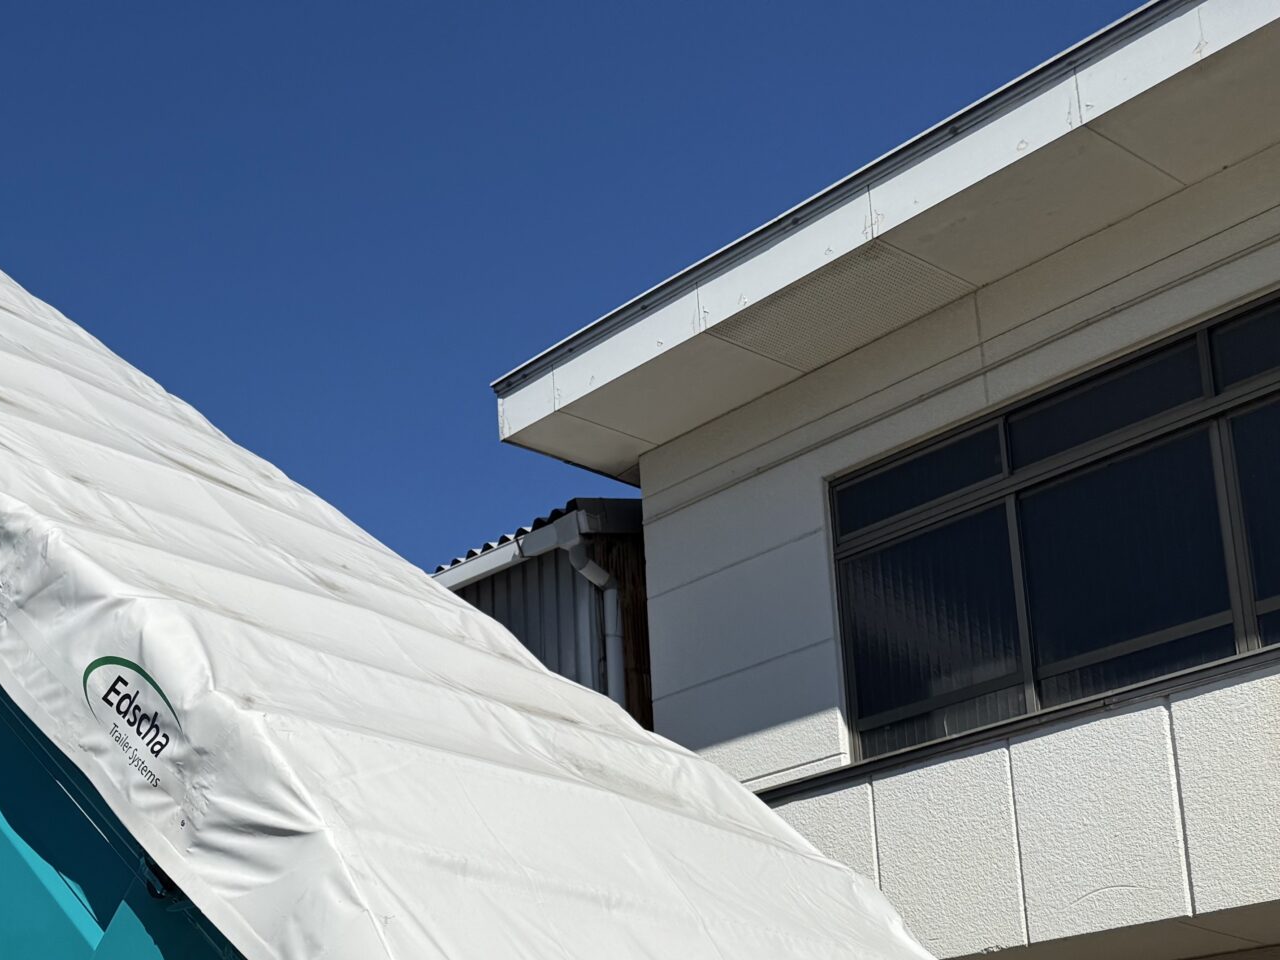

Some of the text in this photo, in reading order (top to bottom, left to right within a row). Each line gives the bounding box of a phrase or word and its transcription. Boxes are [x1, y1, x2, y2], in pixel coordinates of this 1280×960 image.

[102, 675, 170, 758] Edscha
[109, 723, 160, 788] Trailer Systems
